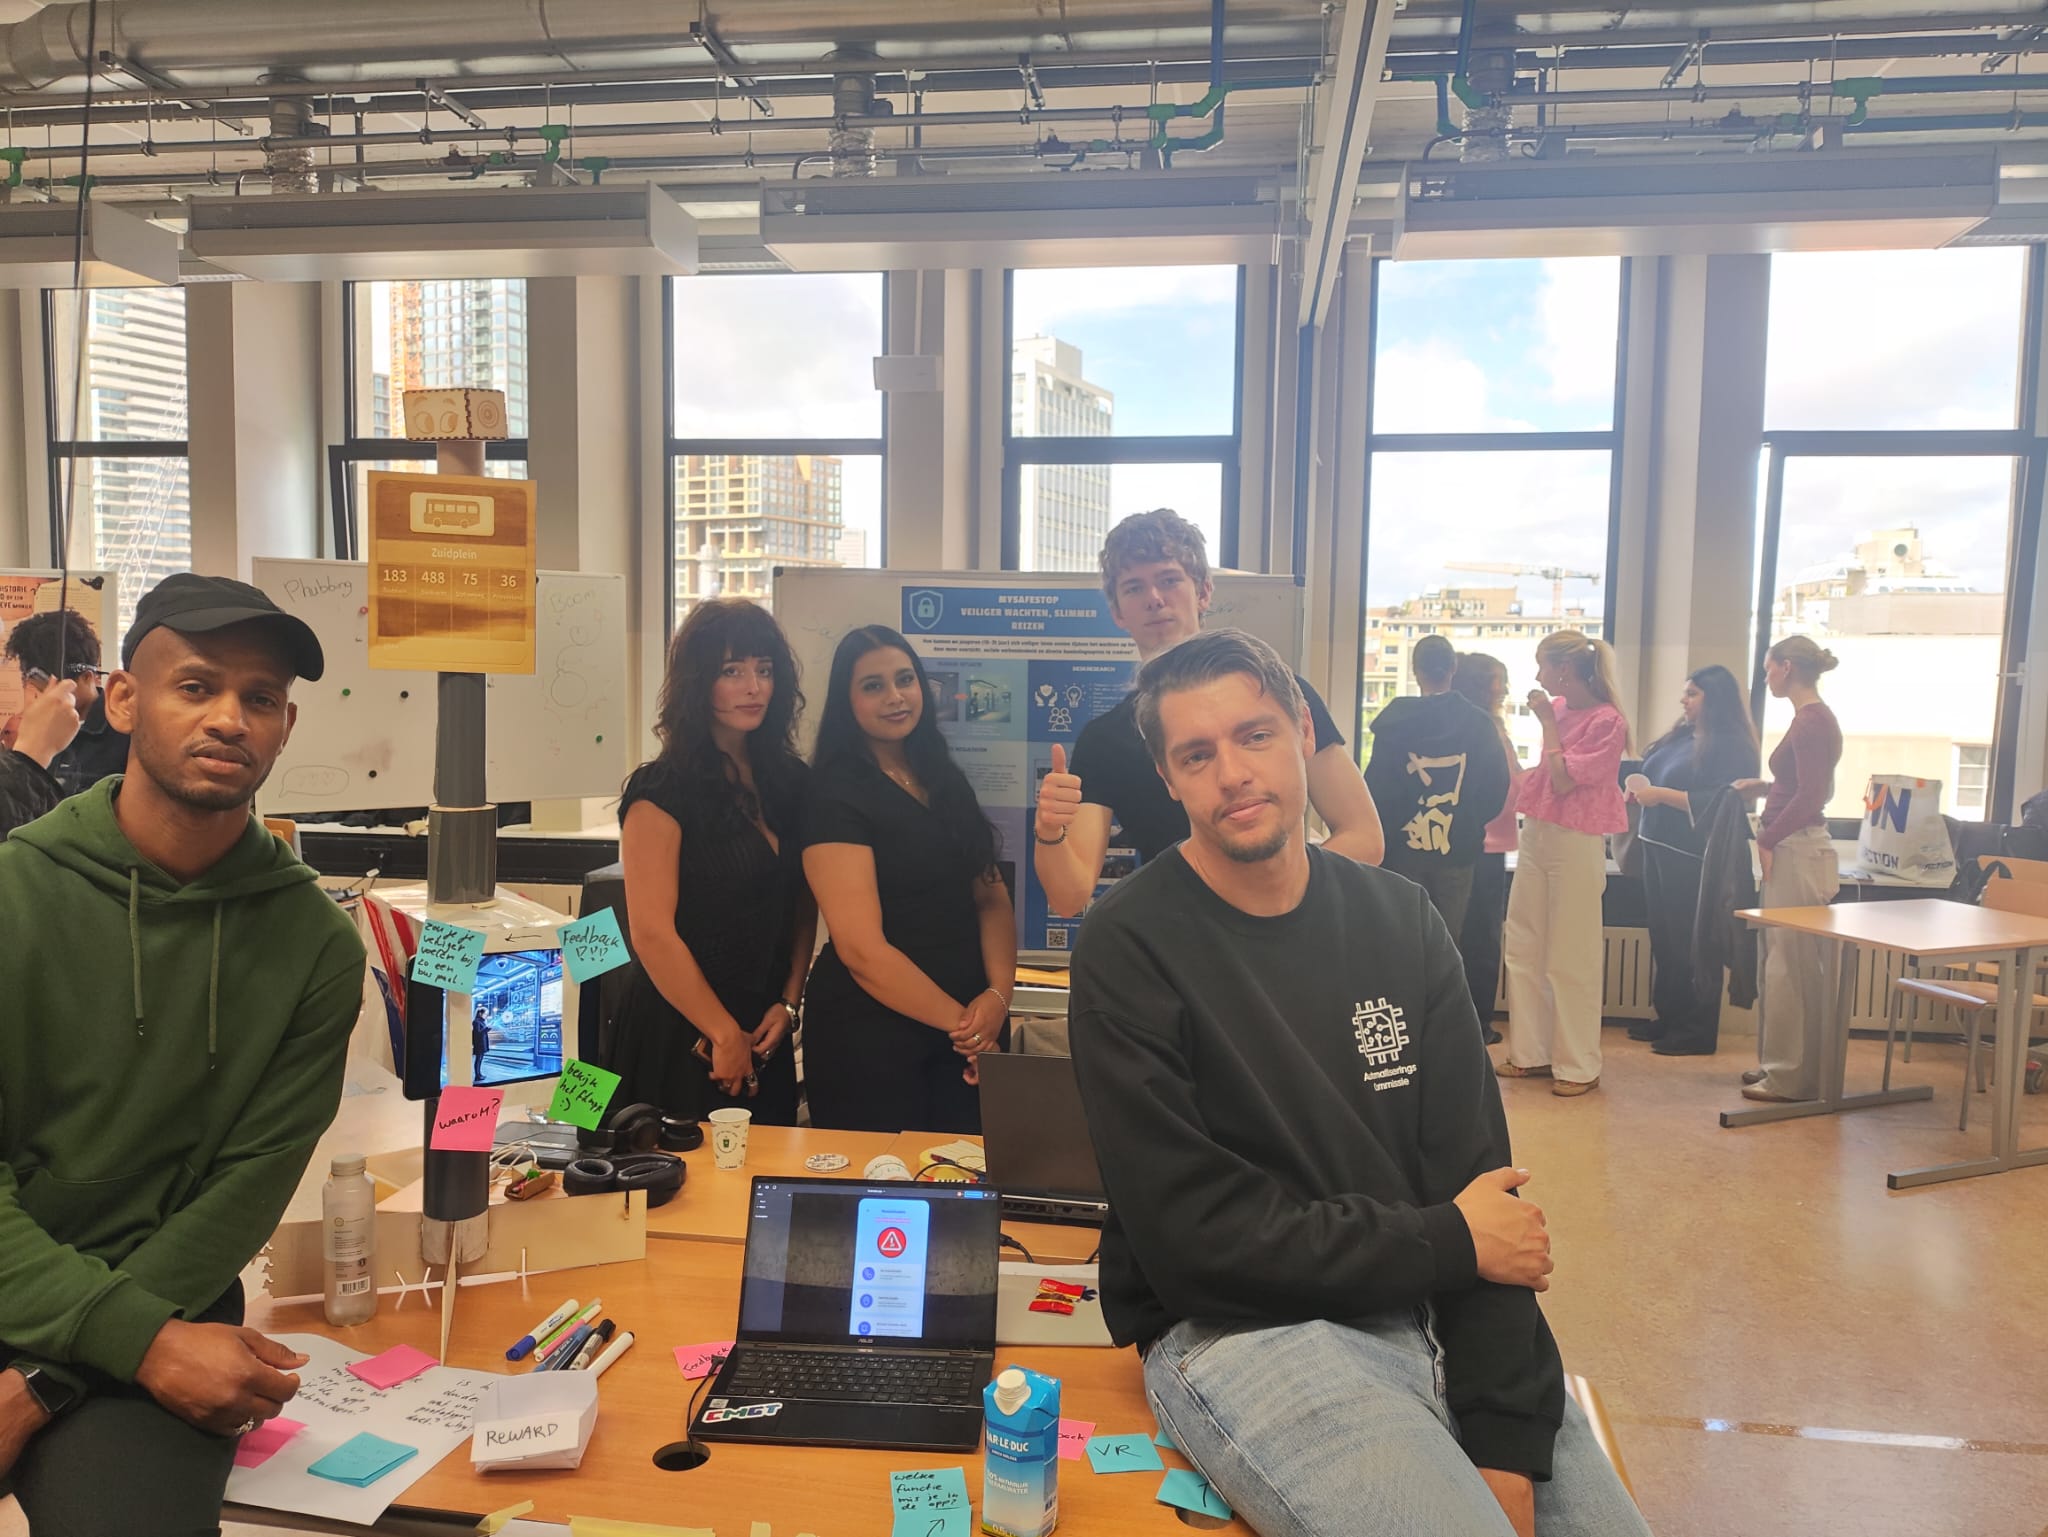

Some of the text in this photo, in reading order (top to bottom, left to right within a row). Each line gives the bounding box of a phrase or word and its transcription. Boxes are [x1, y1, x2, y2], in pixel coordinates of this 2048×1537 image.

[432, 547, 477, 560] Zuidplein
[383, 569, 517, 588] 183 488 75 36
[961, 608, 1002, 616] VEILIGER
[1054, 609, 1097, 618] SLIMMER
[1011, 621, 1045, 630] REIZEN
[443, 925, 457, 939] je
[458, 930, 474, 944] je
[563, 925, 618, 947] Feedback
[706, 1405, 781, 1421] CMGT
[1094, 1443, 1142, 1458] VR
[896, 1483, 943, 1493] functie
